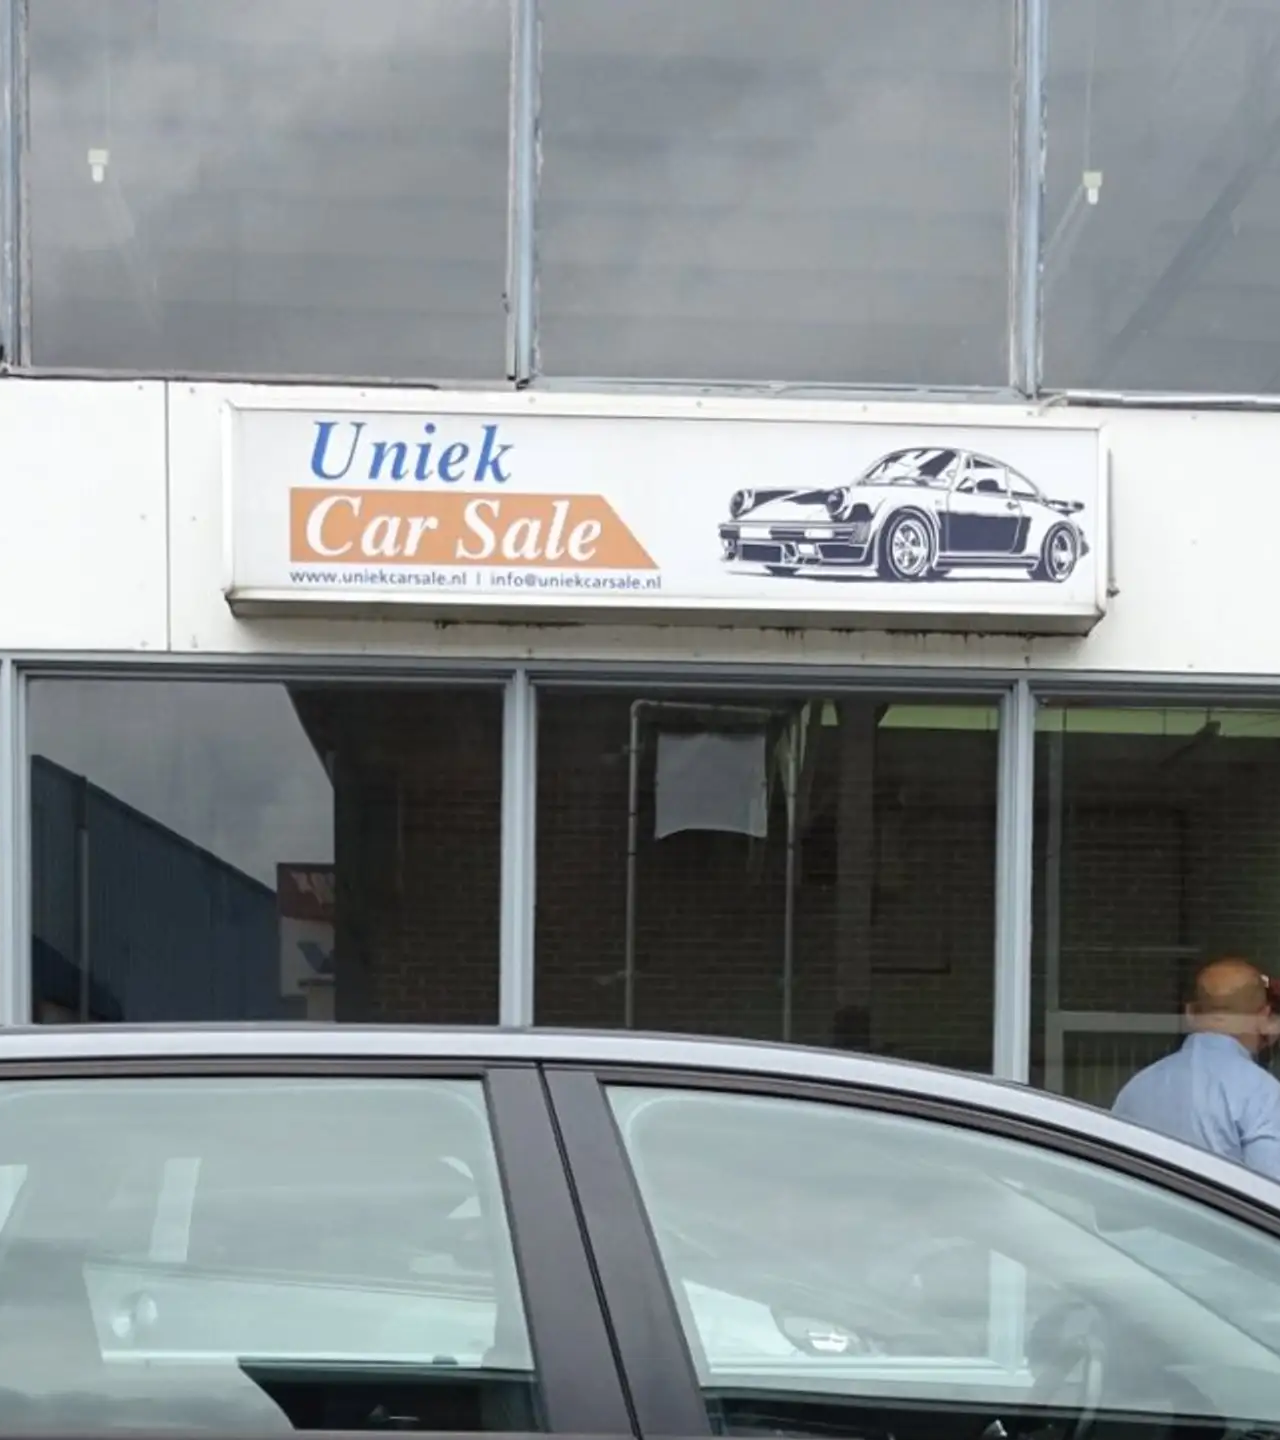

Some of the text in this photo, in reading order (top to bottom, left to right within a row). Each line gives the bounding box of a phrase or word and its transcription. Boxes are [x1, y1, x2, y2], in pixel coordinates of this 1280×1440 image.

[310, 420, 514, 484] Uniek
[305, 494, 602, 562] Car Sale
[289, 567, 467, 586] www.uniekcarsale.nl
[490, 571, 662, 590] info@uniekcarsale.nl
